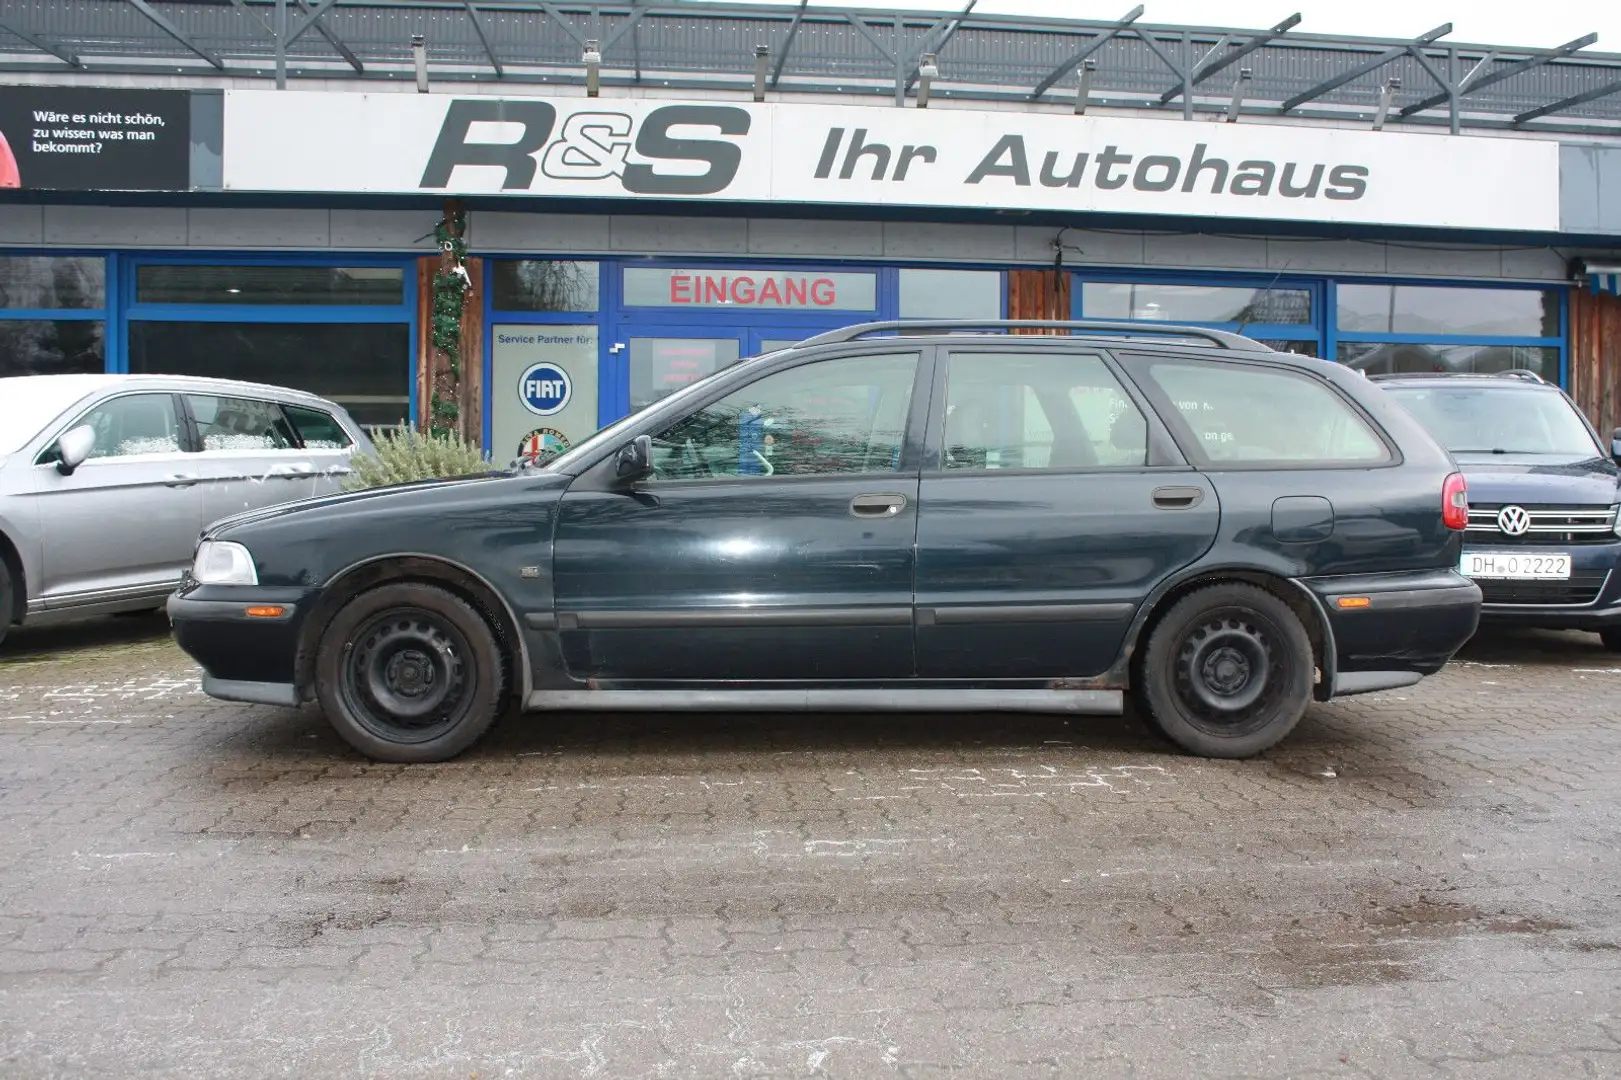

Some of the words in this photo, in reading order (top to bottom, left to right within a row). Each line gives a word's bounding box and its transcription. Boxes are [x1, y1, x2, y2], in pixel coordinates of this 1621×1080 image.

[33, 110, 69, 123] Wäre
[72, 114, 86, 123] es
[89, 112, 122, 124] nicht
[124, 112, 165, 127] schön,
[33, 128, 49, 138] zu
[52, 127, 95, 139] wissen
[98, 130, 124, 140] was
[126, 131, 155, 140] man
[32, 140, 103, 153] bekommt?
[419, 99, 751, 194] R&S
[814, 127, 937, 182] Ihr
[963, 134, 1370, 201] Autohaus
[670, 275, 836, 306] EINGANG
[498, 334, 535, 344] Service
[537, 335, 574, 344] Partner
[526, 380, 564, 399] FIAT
[1472, 557, 1495, 573] DH
[1523, 557, 1566, 574] 2222
